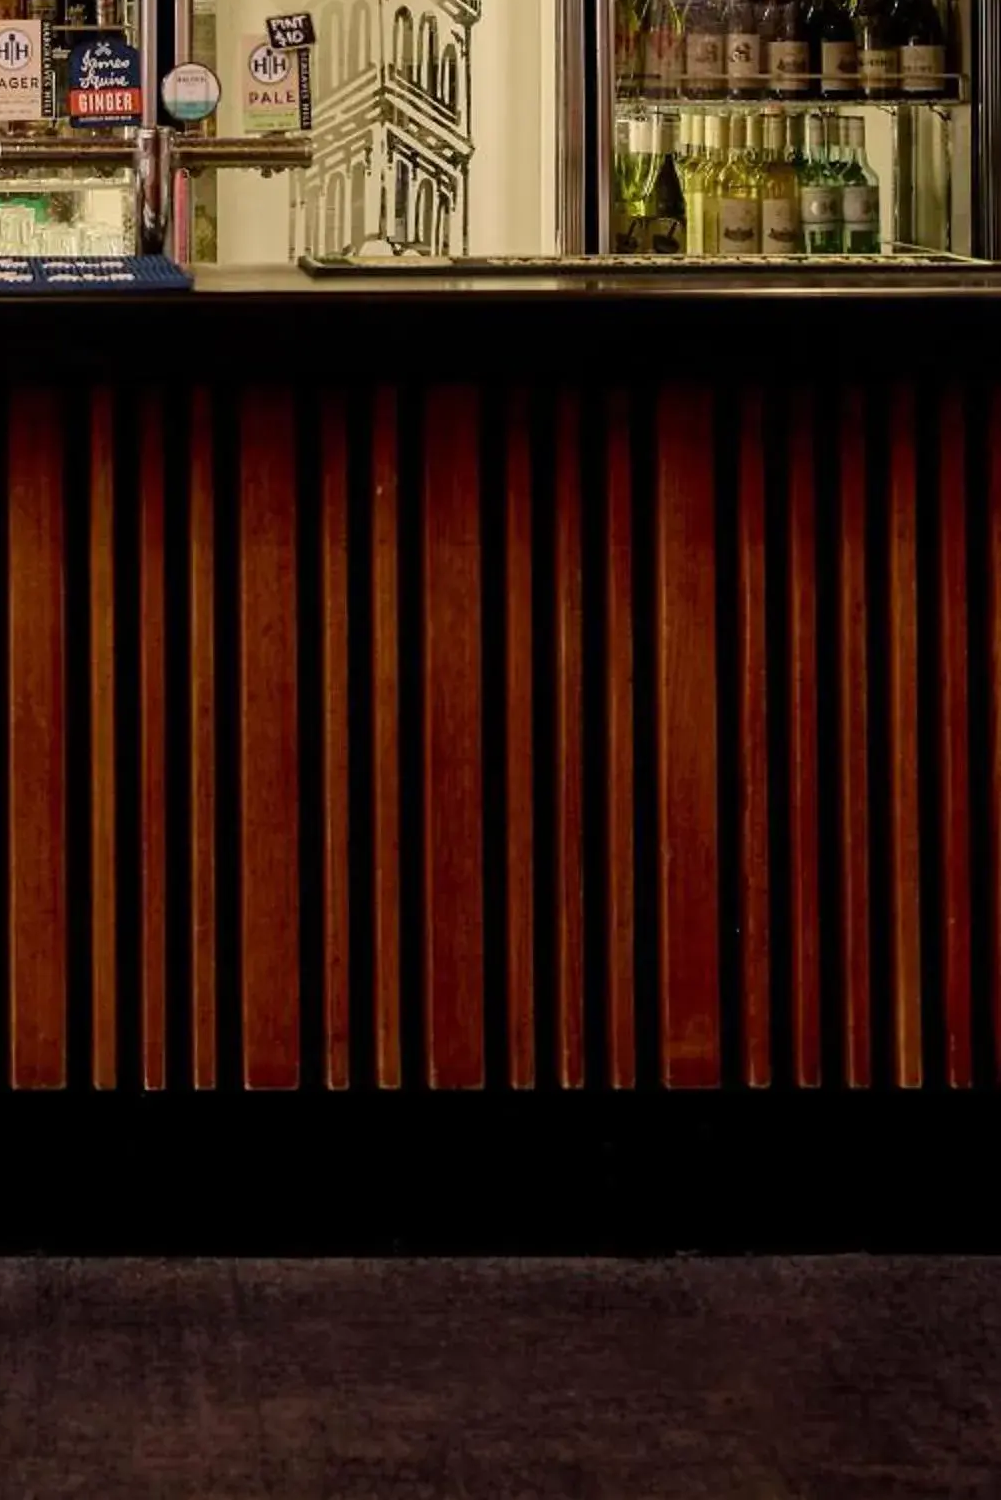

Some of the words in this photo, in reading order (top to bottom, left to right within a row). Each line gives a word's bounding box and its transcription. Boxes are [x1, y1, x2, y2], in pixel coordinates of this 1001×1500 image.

[270, 17, 306, 30] PINT
[274, 30, 304, 47] $10
[77, 92, 133, 114] GINGER
[248, 91, 295, 106] PALE
